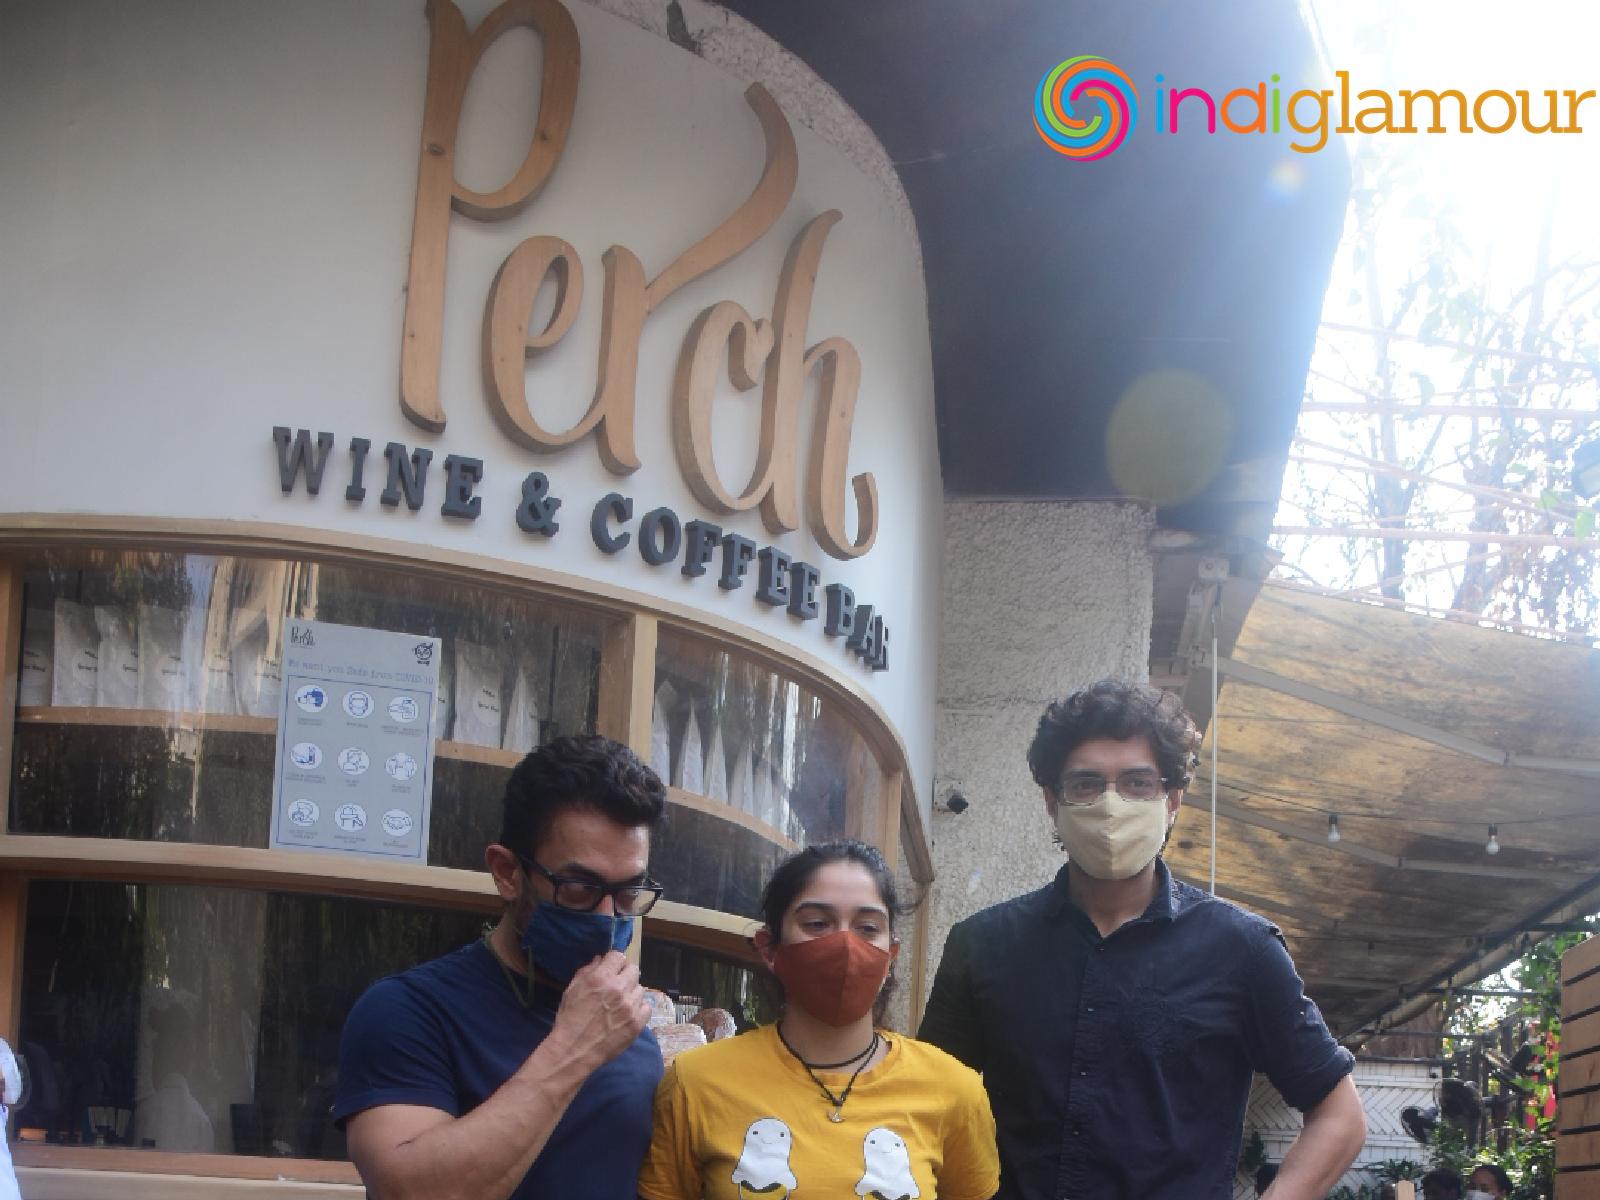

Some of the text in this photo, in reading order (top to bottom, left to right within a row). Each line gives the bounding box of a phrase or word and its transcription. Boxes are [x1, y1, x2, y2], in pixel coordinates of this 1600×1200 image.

[400, 0, 880, 561] Perch
[272, 425, 889, 672] WINE & COFFEE BAR
[327, 664, 345, 674] you
[371, 669, 393, 680] from
